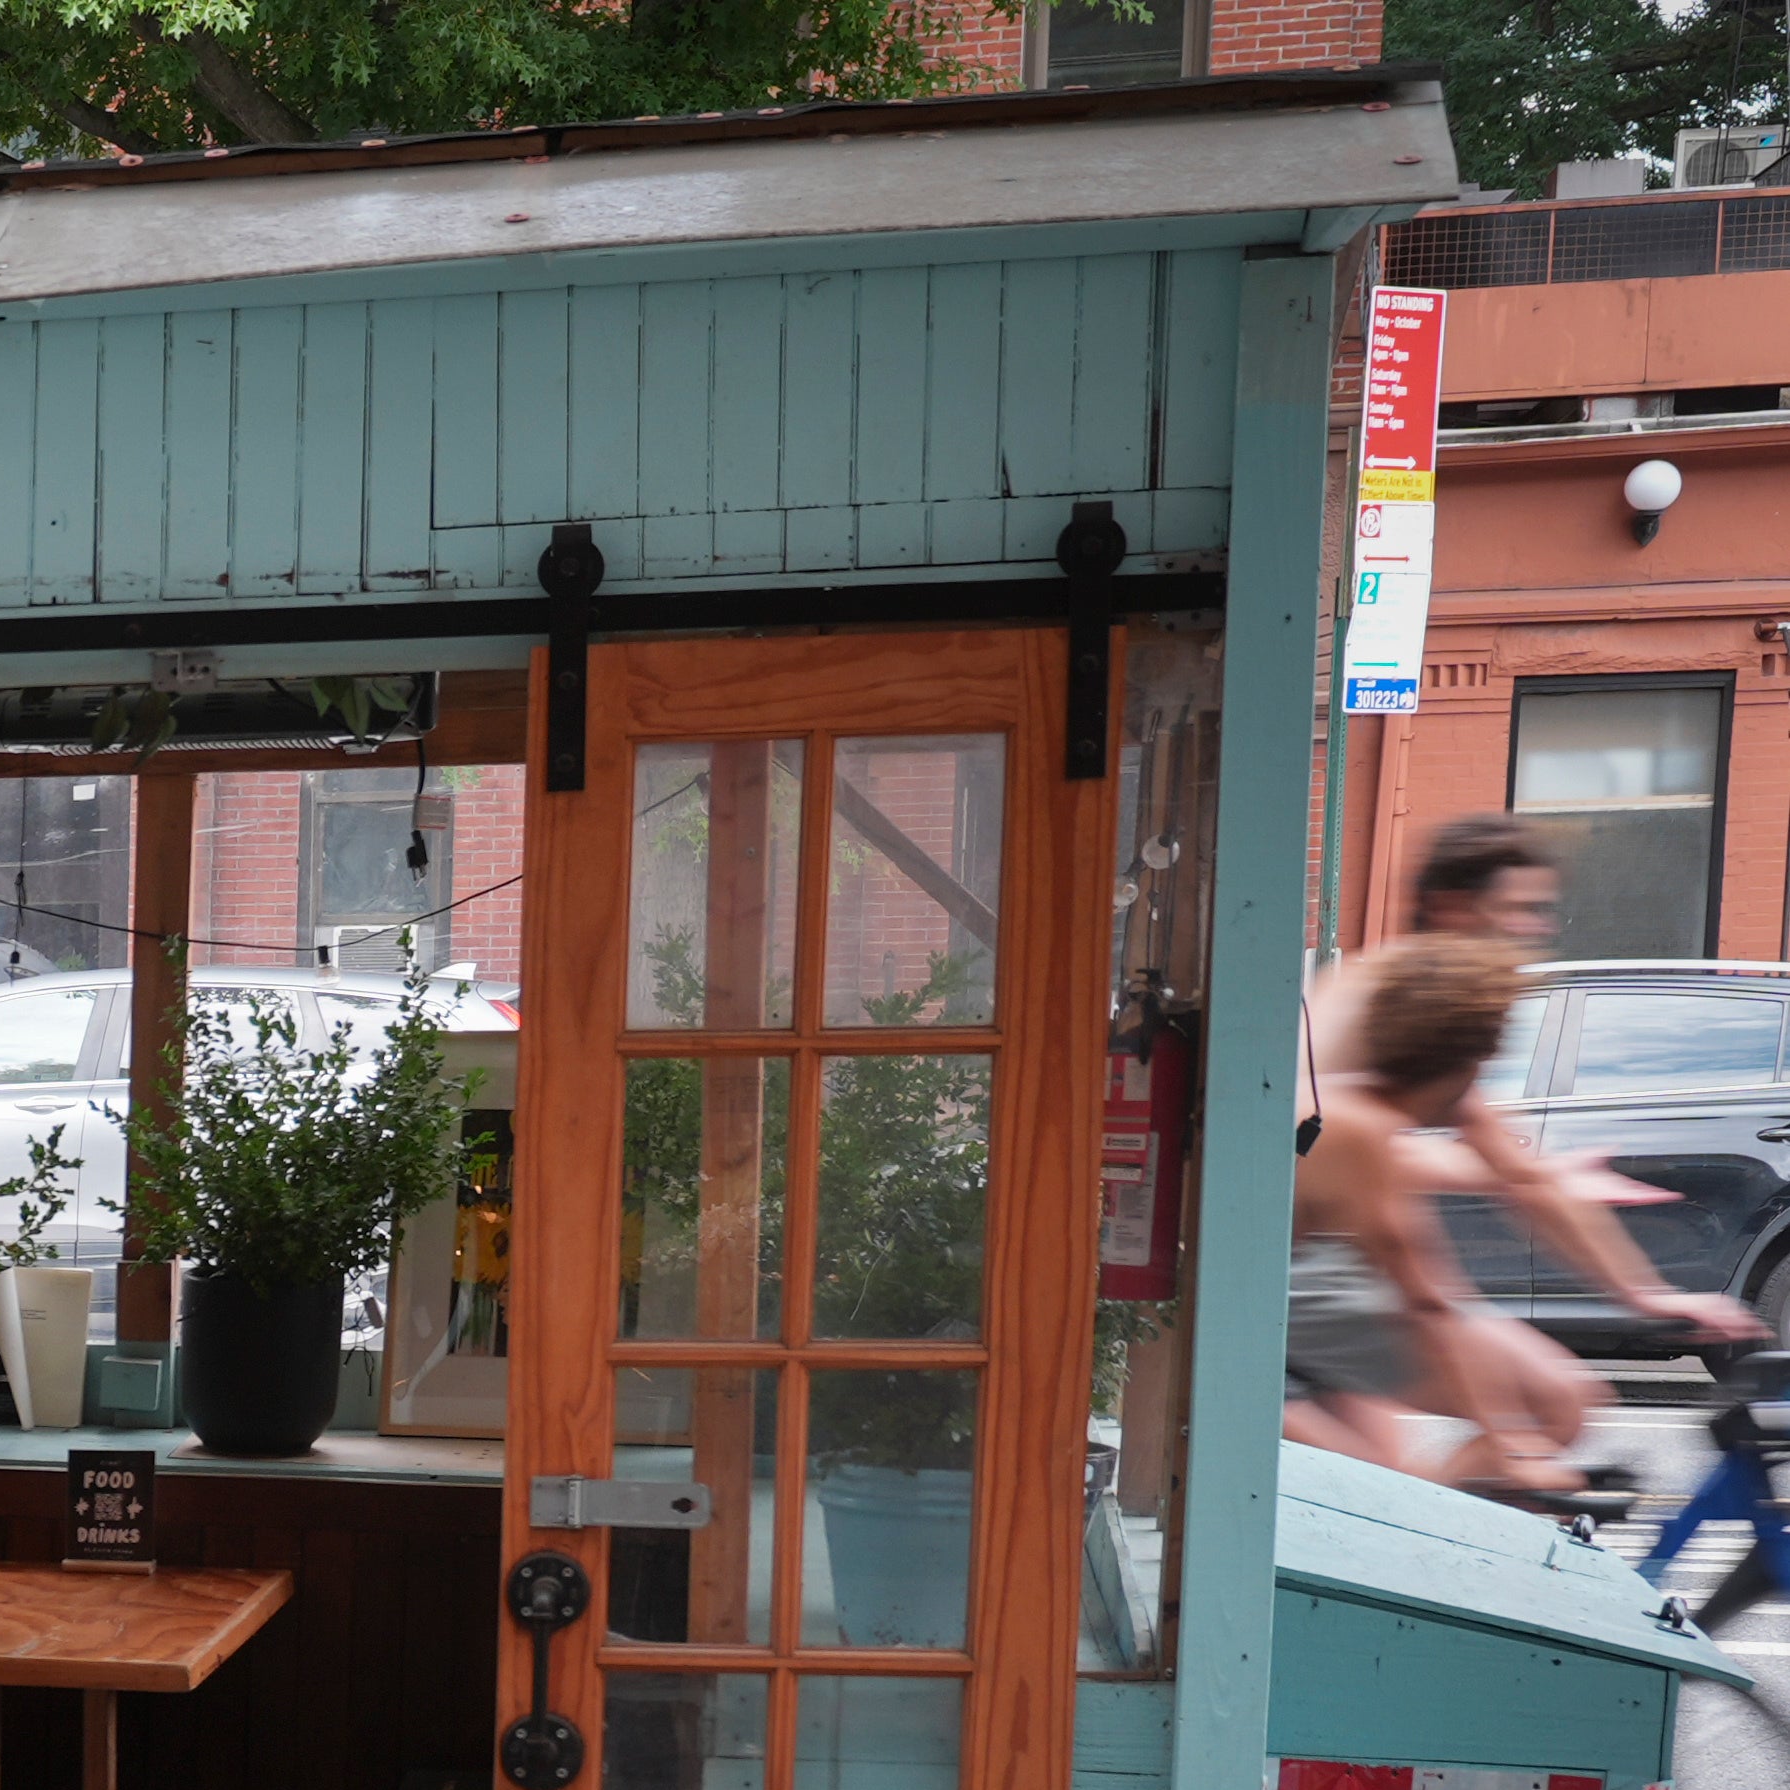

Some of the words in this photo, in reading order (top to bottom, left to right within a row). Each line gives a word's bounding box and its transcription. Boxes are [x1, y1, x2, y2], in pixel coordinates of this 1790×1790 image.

[1376, 295, 1390, 309] NO
[1391, 296, 1434, 312] STANDING
[1373, 334, 1395, 349] Friday
[1371, 368, 1402, 383] Saturday
[1369, 401, 1394, 416] Sunday
[1365, 475, 1387, 486] Meters
[1389, 475, 1400, 486] Are
[1402, 477, 1413, 487] Not
[1364, 489, 1383, 500] Effect
[1386, 489, 1405, 500] Above
[1361, 574, 1376, 603] 2
[1355, 690, 1399, 709] 301223
[82, 1470, 136, 1490] FOOD
